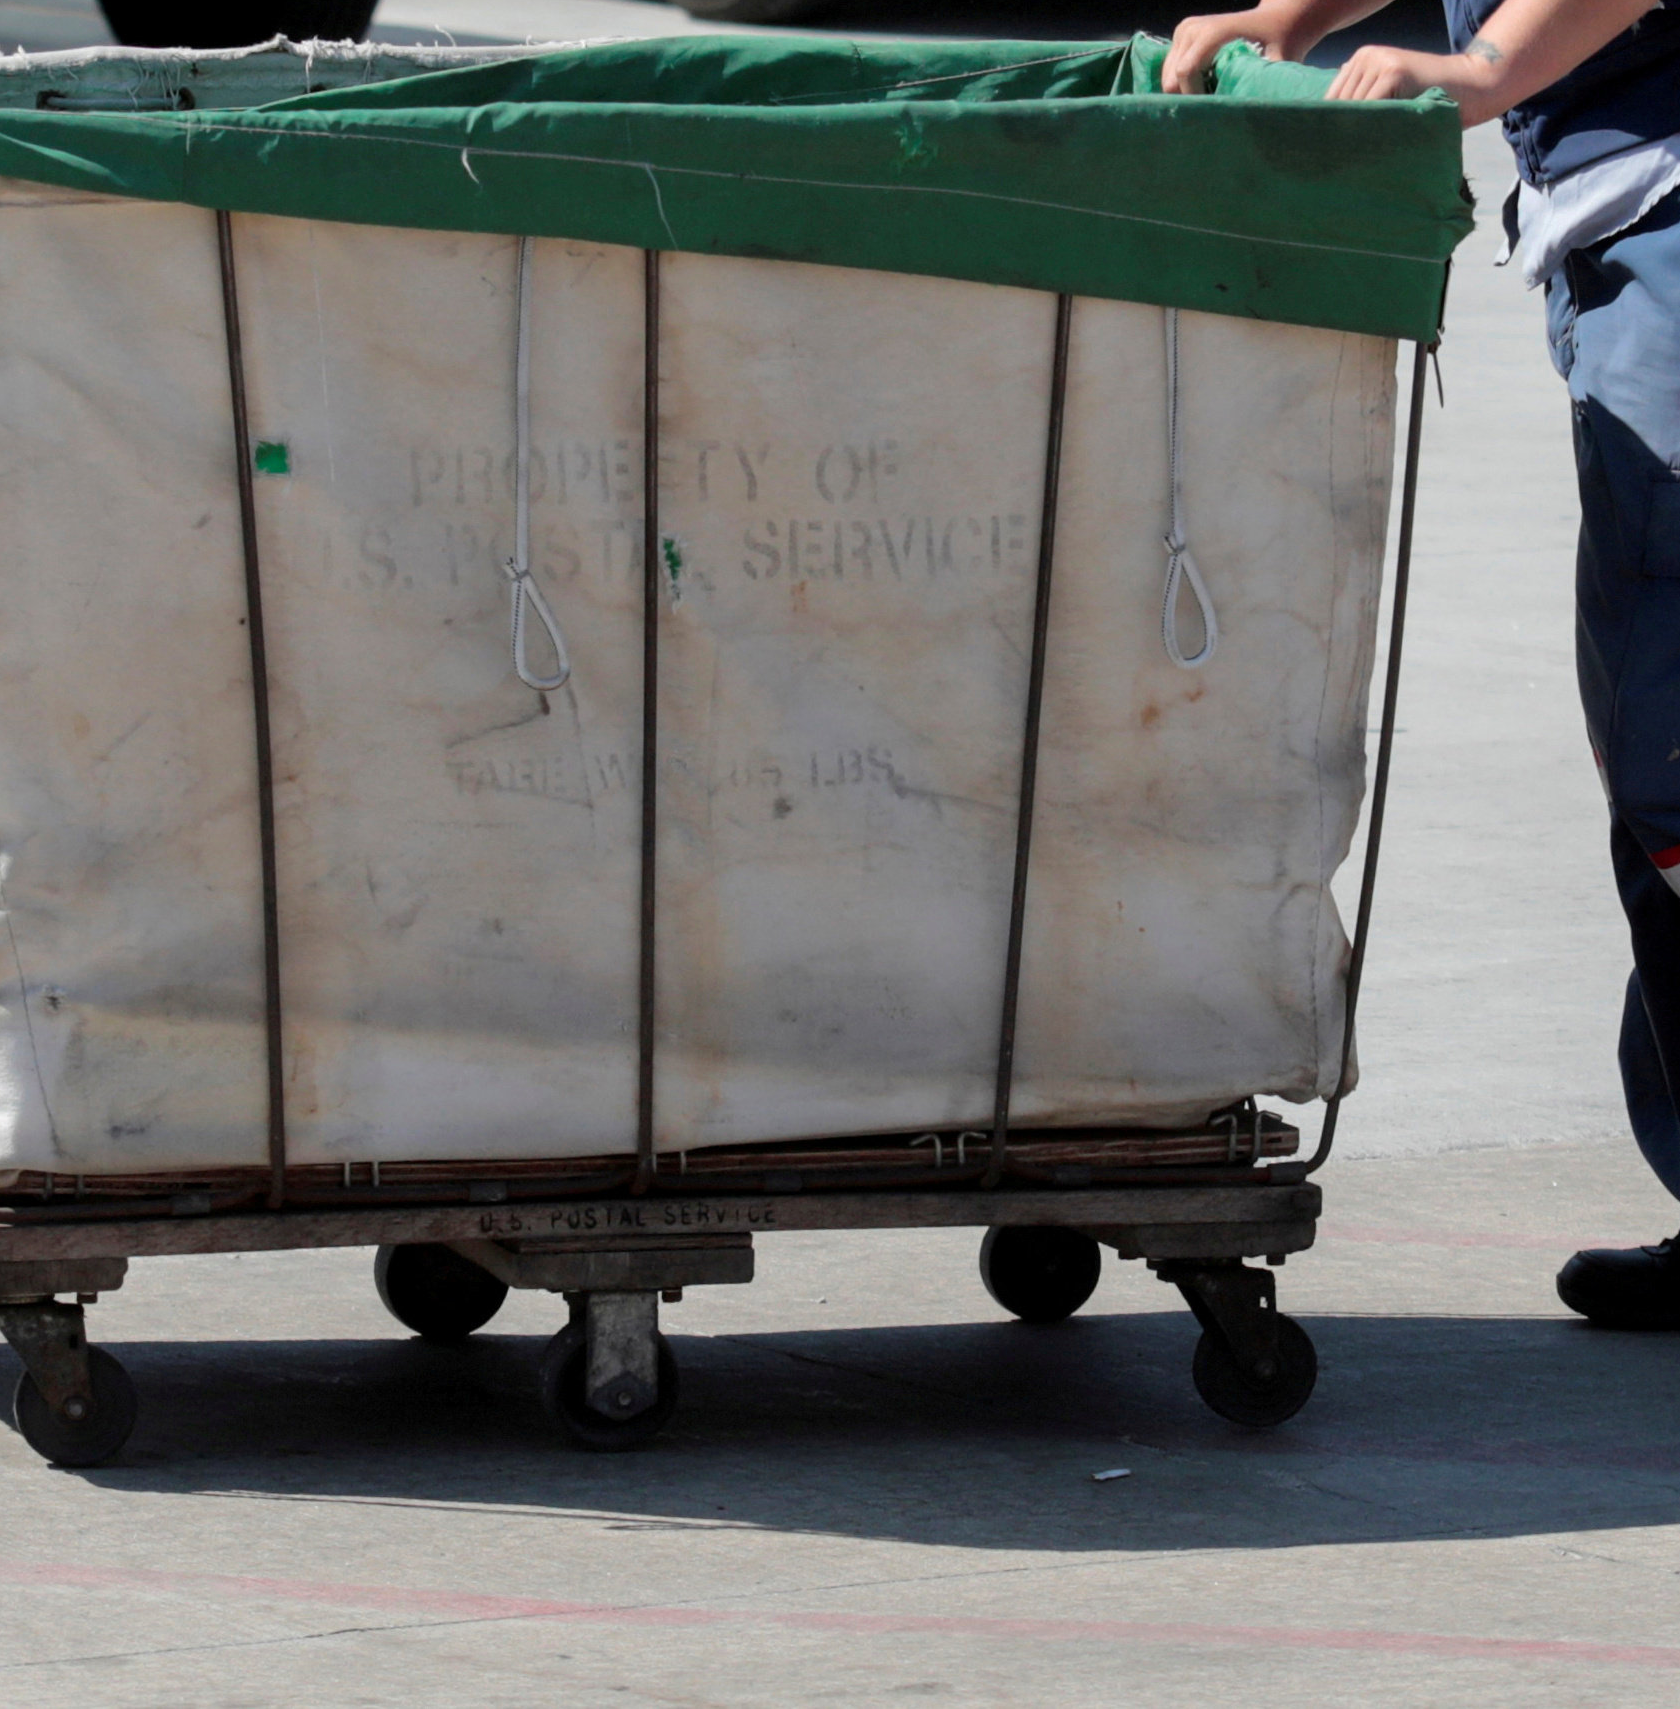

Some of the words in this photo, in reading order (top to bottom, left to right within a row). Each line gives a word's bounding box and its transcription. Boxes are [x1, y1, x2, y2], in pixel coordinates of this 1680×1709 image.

[410, 440, 772, 508] PROPETY
[814, 438, 899, 505] OF
[743, 513, 1026, 582] SERVICE
[550, 1205, 648, 1230] POSTAL
[663, 1200, 778, 1226] SERVICE
